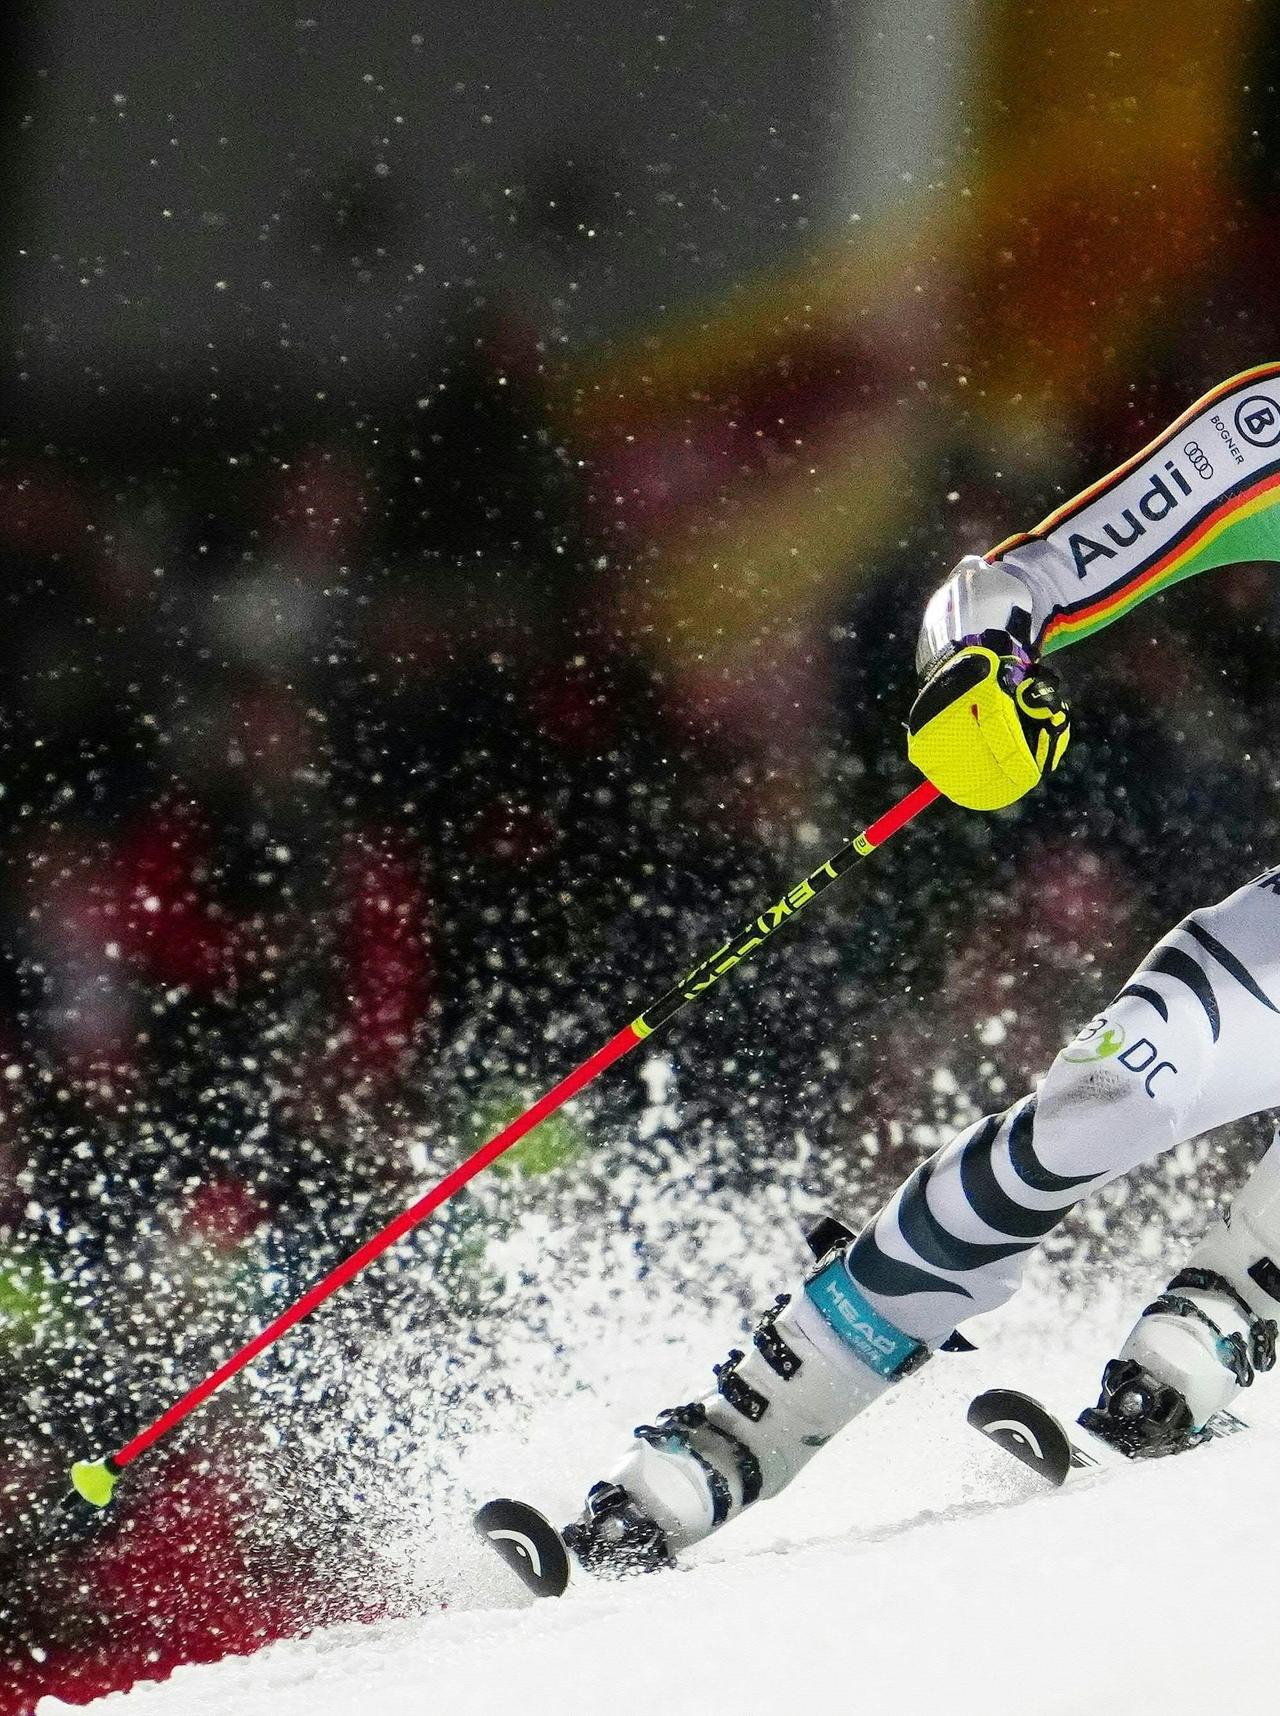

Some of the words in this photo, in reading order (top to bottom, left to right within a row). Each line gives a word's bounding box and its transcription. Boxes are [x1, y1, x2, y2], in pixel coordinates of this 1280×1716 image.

[1210, 415, 1245, 465] BOGNER
[1068, 460, 1193, 579] Audi
[826, 1281, 896, 1354] HEAD
